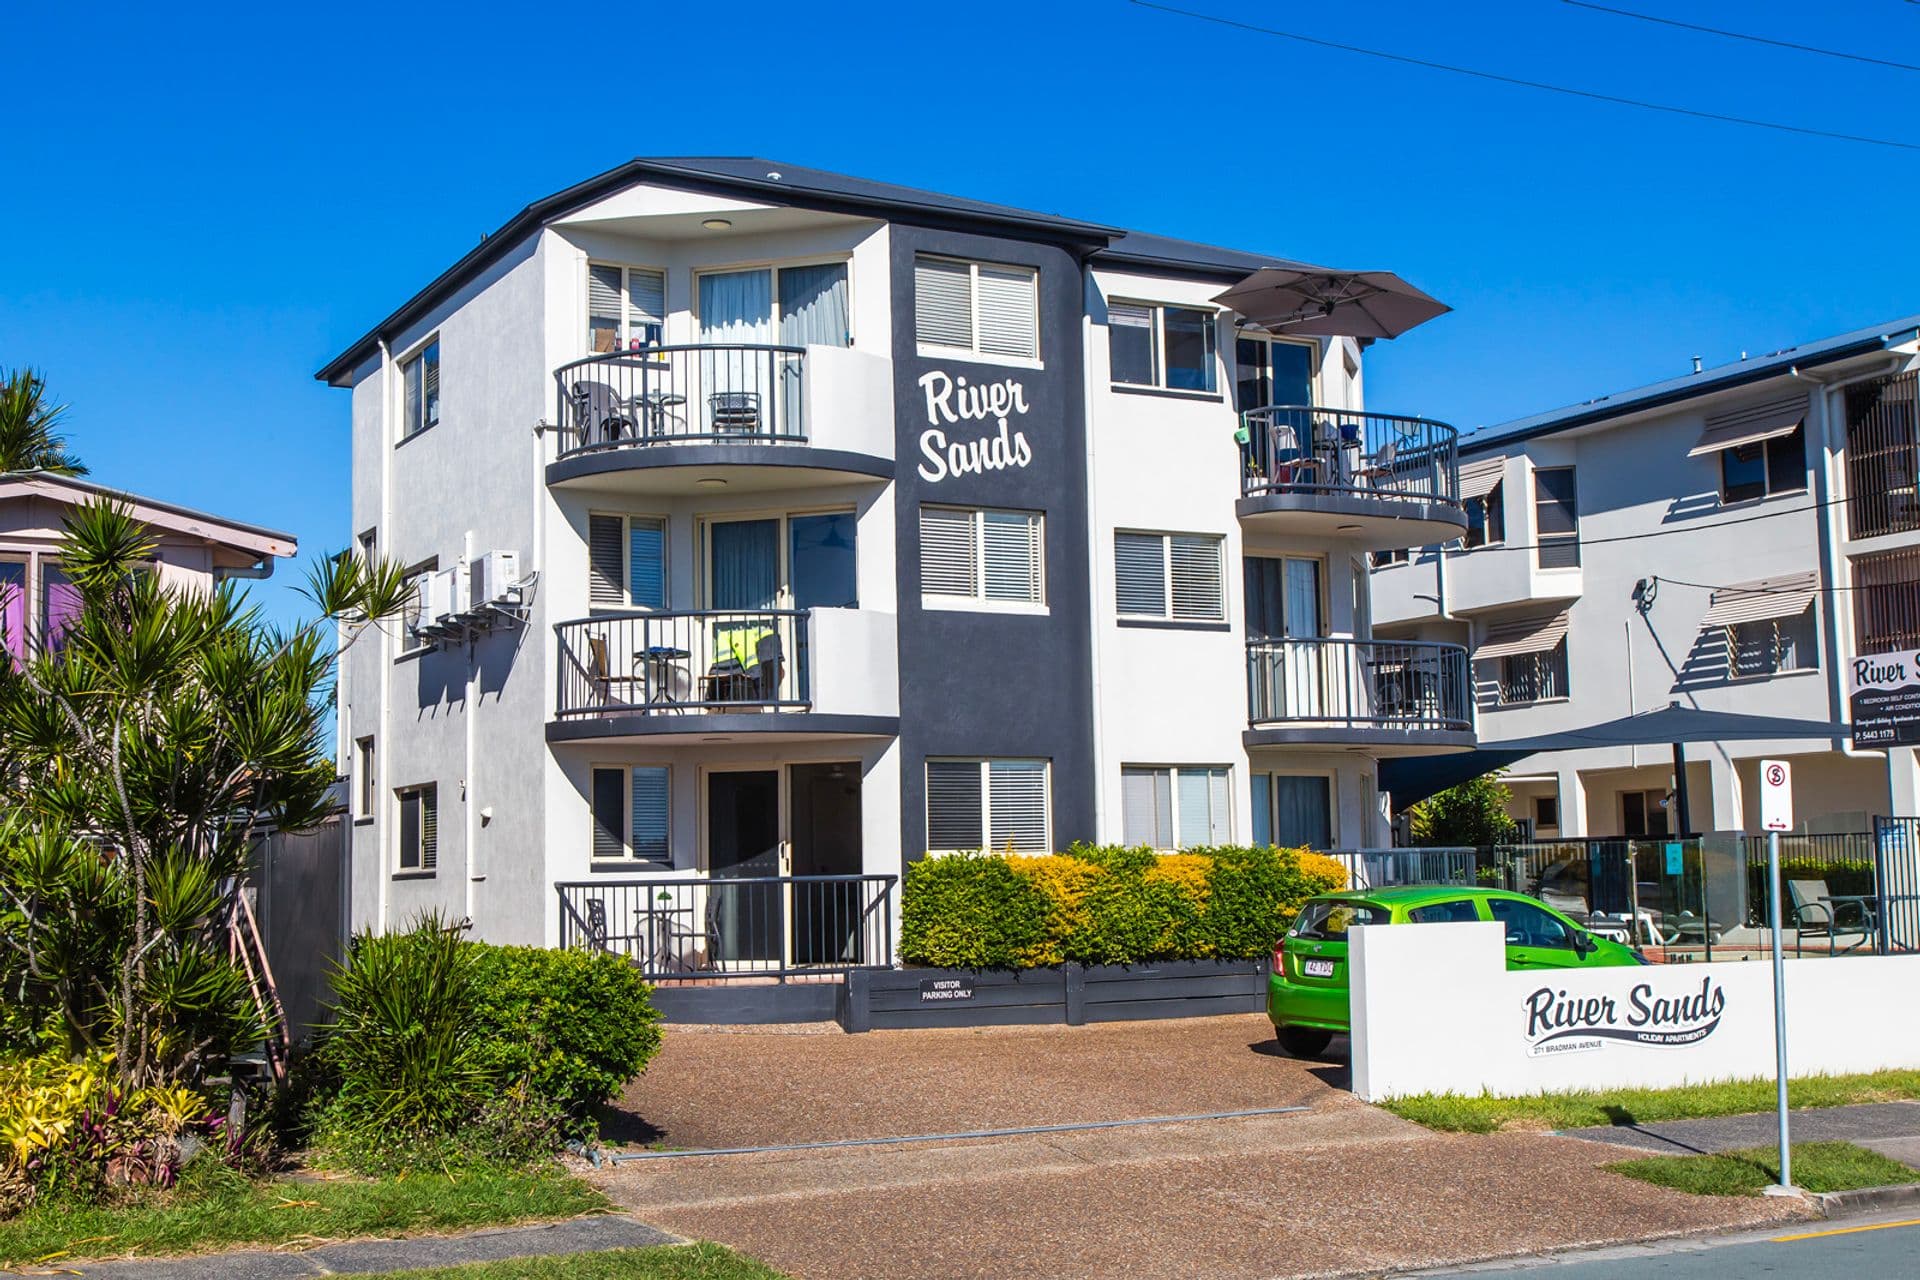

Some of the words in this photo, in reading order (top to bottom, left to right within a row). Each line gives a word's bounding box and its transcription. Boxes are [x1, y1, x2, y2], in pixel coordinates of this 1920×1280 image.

[918, 370, 1030, 425] River
[917, 417, 1032, 482] Sands
[1853, 658, 1907, 686] River
[922, 990, 953, 1000] PARKING
[953, 989, 972, 998] ONLY
[933, 980, 961, 989] VISITOR
[1526, 987, 1618, 1036] River
[1627, 976, 1725, 1027] Sands
[1546, 1042, 1577, 1053] BRADMAN
[1579, 1039, 1602, 1049] AVENUE
[1637, 1032, 1665, 1042] HOLIDAY
[1665, 1028, 1708, 1043] APARTMENTS
